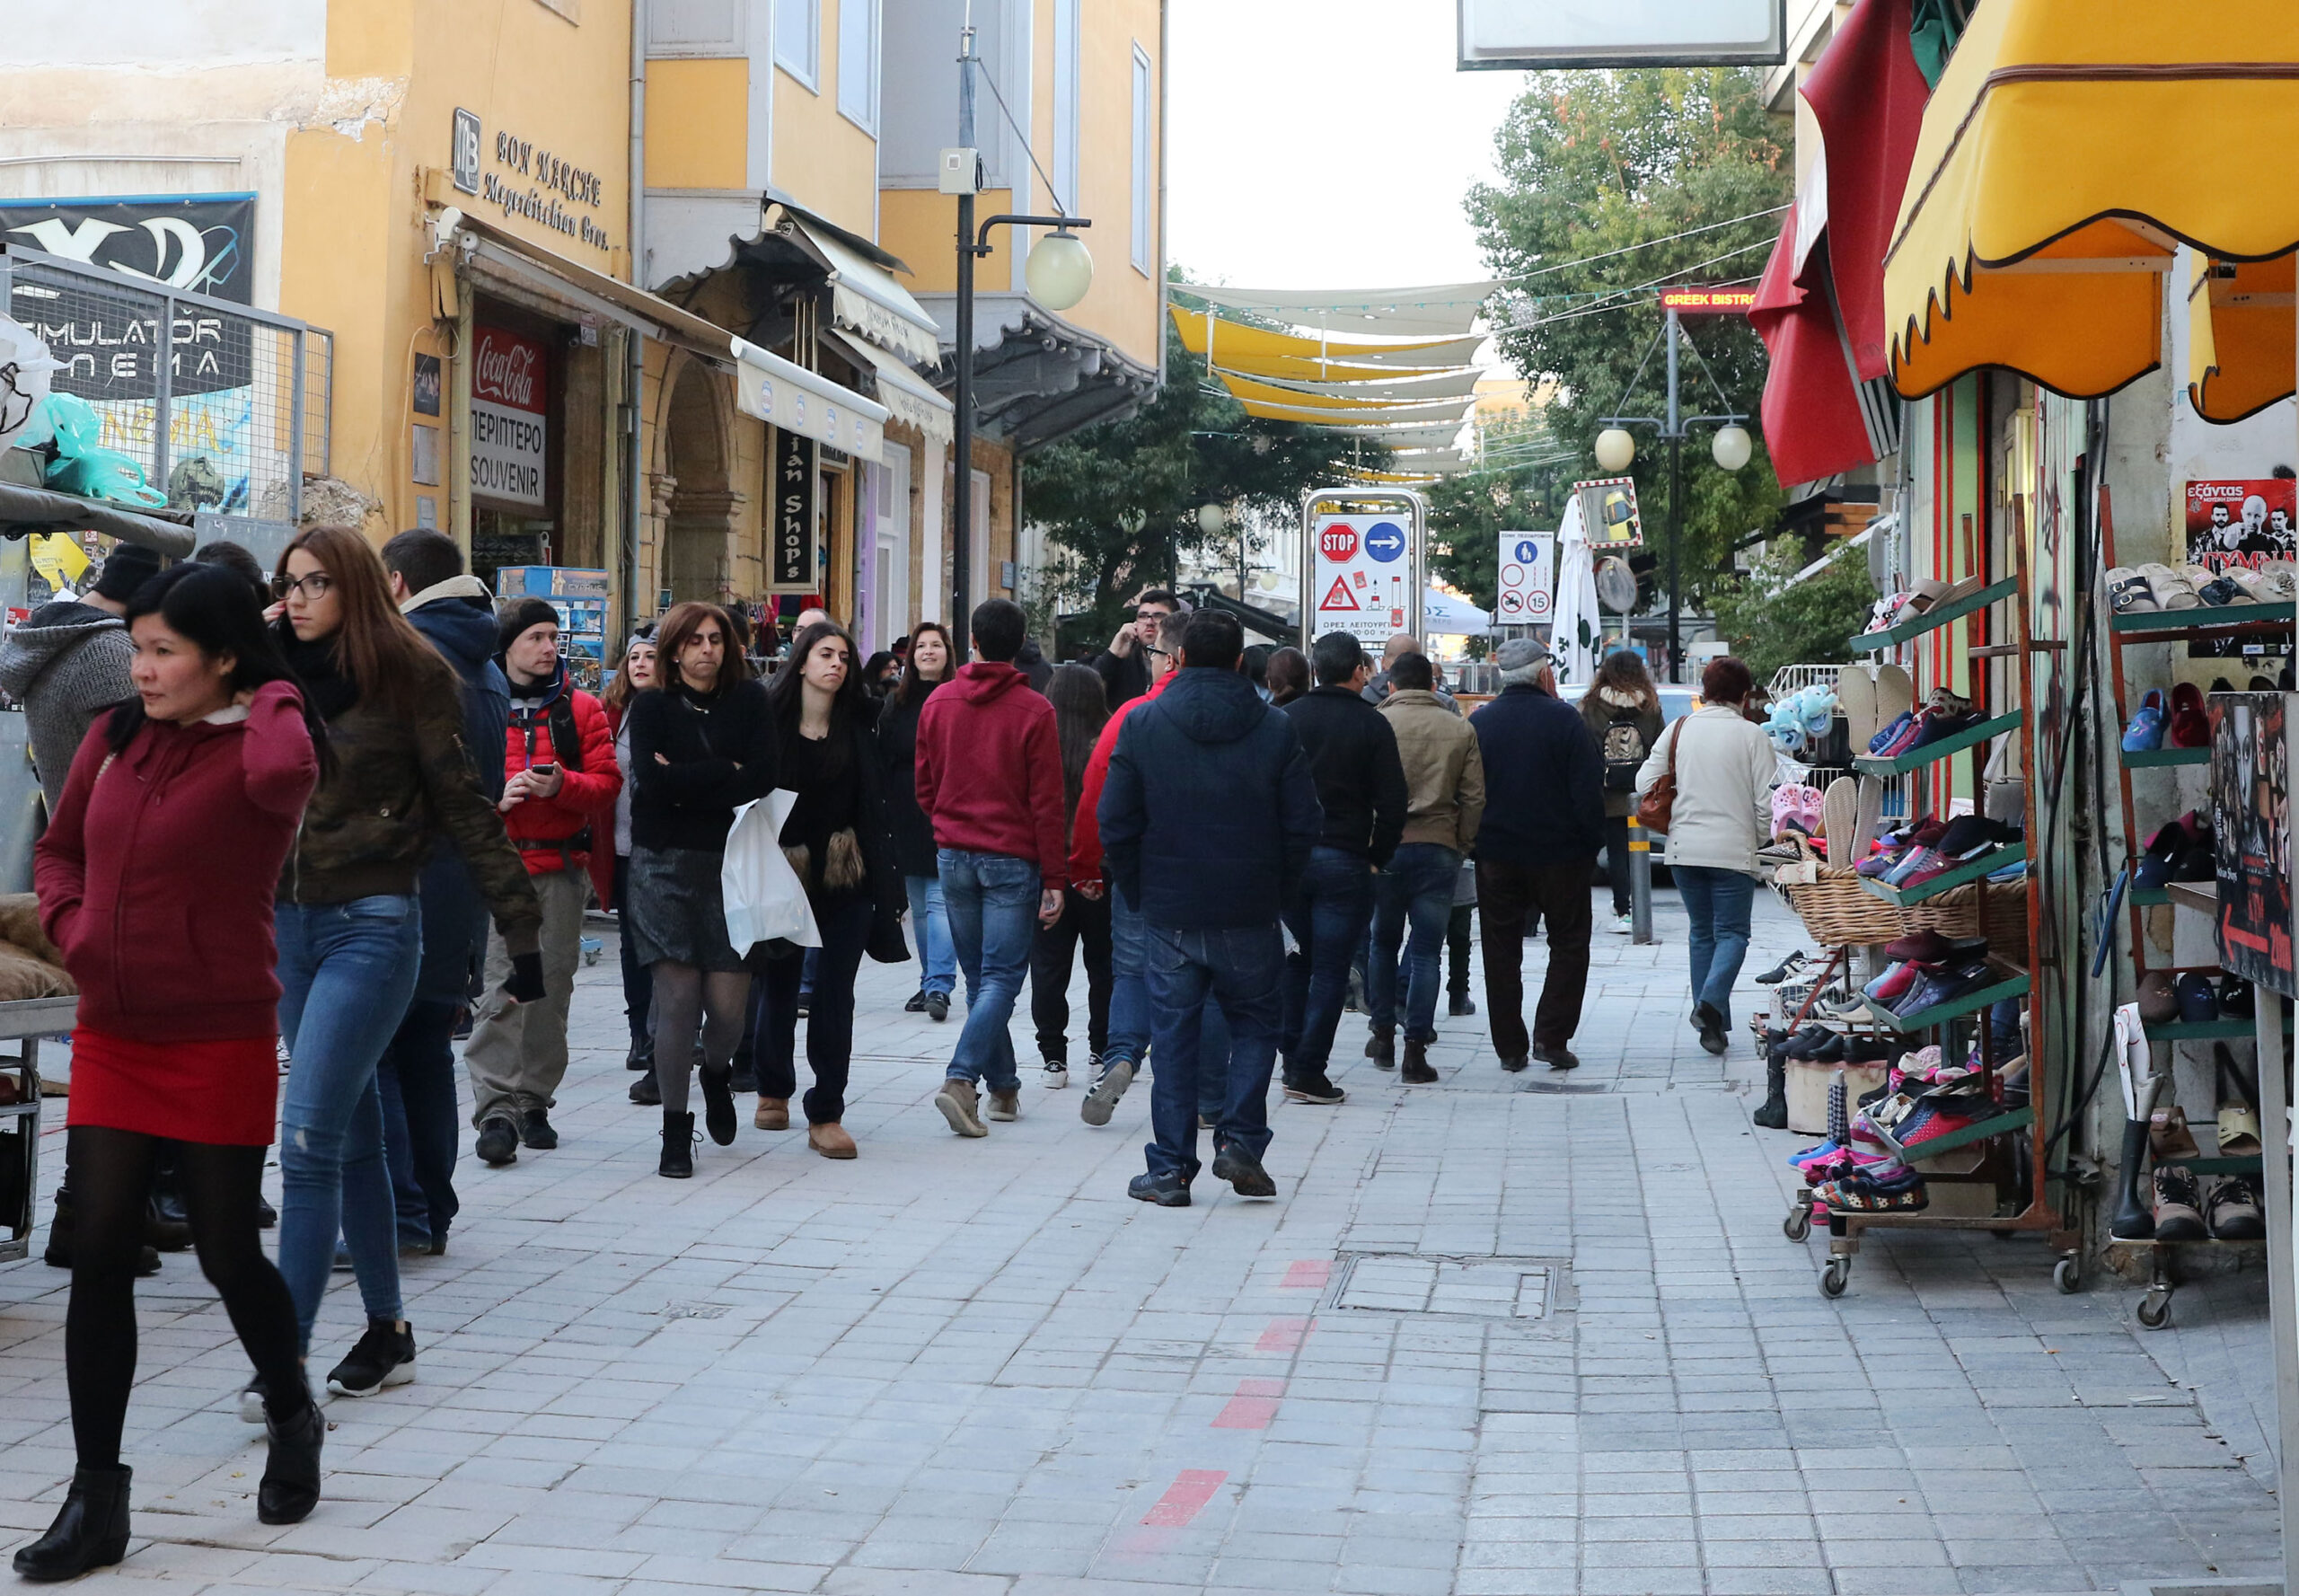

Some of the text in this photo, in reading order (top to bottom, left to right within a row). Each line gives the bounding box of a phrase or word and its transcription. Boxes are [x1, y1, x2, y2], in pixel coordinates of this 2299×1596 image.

[498, 130, 601, 207] BON MARCHE
[1664, 294, 1710, 305] GREEK
[476, 335, 536, 405] Coca-Cola
[471, 455, 539, 497] SOUVENIR
[2187, 483, 2244, 499] εξάντας
[783, 495, 803, 578] Shops
[1323, 533, 1355, 551] STOP
[568, 583, 603, 592] CYPRUS
[1532, 597, 1545, 608] 15
